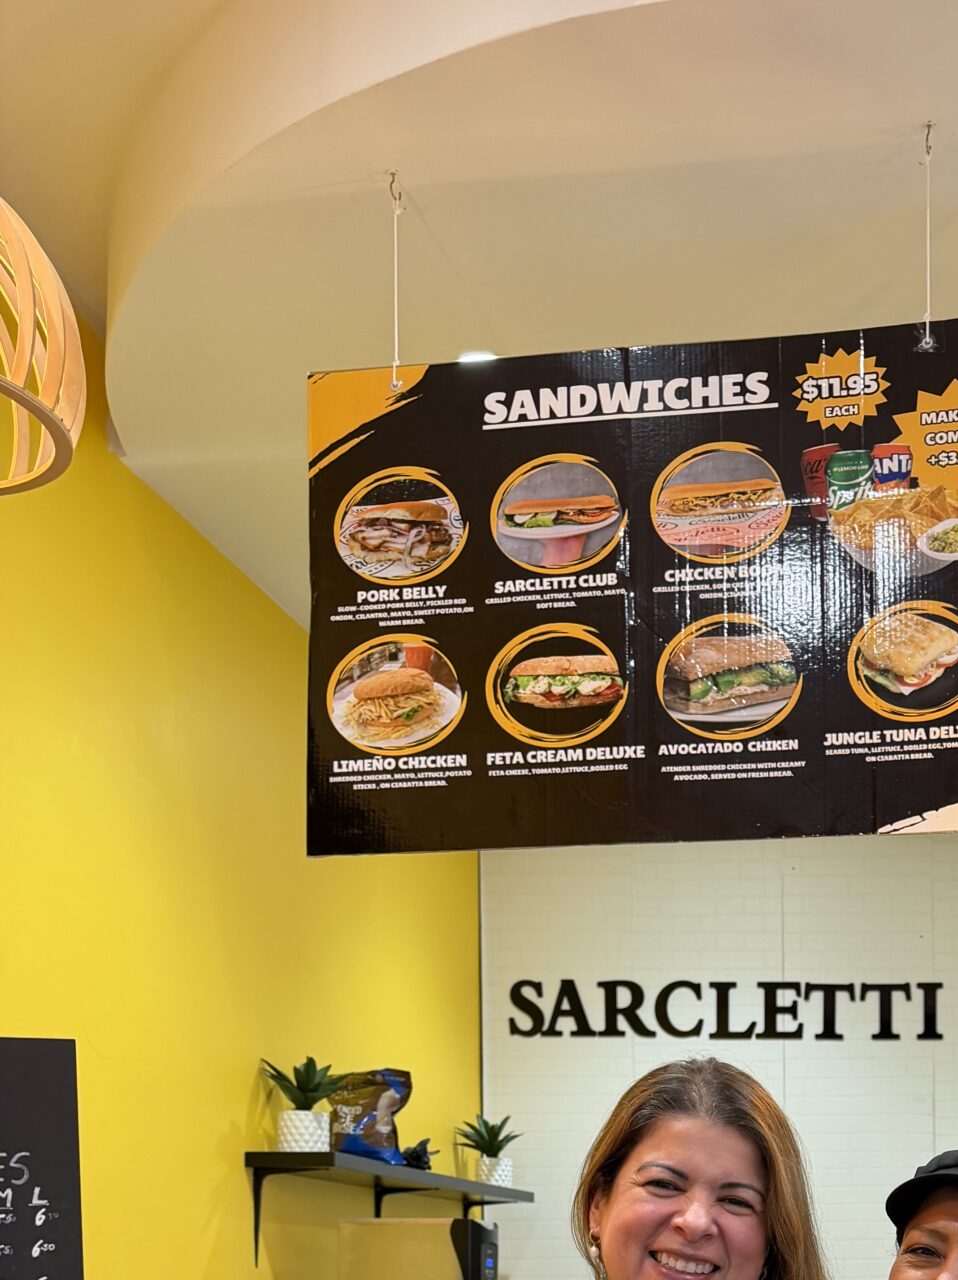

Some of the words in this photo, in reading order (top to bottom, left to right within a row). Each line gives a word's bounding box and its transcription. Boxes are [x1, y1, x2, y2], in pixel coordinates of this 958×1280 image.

[802, 373, 880, 401] $11.95
[483, 371, 770, 424] SANDWICHES
[825, 404, 859, 418] EACH
[664, 565, 736, 582] CHICKEN
[494, 576, 577, 594] SARCLETTI
[578, 573, 618, 587] CLUB
[357, 589, 400, 603] PORK
[402, 585, 447, 600] BELLY
[823, 731, 882, 746] JUNGLE
[883, 728, 927, 742] TUNA
[486, 752, 524, 765] FETA
[526, 749, 583, 763] CREAM
[585, 745, 645, 761] DELUXE
[658, 742, 743, 756] AVOCATADO
[748, 739, 799, 752] CHIKEN
[333, 756, 396, 773] LIMEÑO
[398, 754, 468, 769] CHICKEN
[877, 753, 909, 762] CIABATTA
[910, 752, 934, 760] BREAD.
[737, 772, 747, 780] ON
[508, 979, 944, 1041] SARCLETTI
[32, 1186, 48, 1204] L
